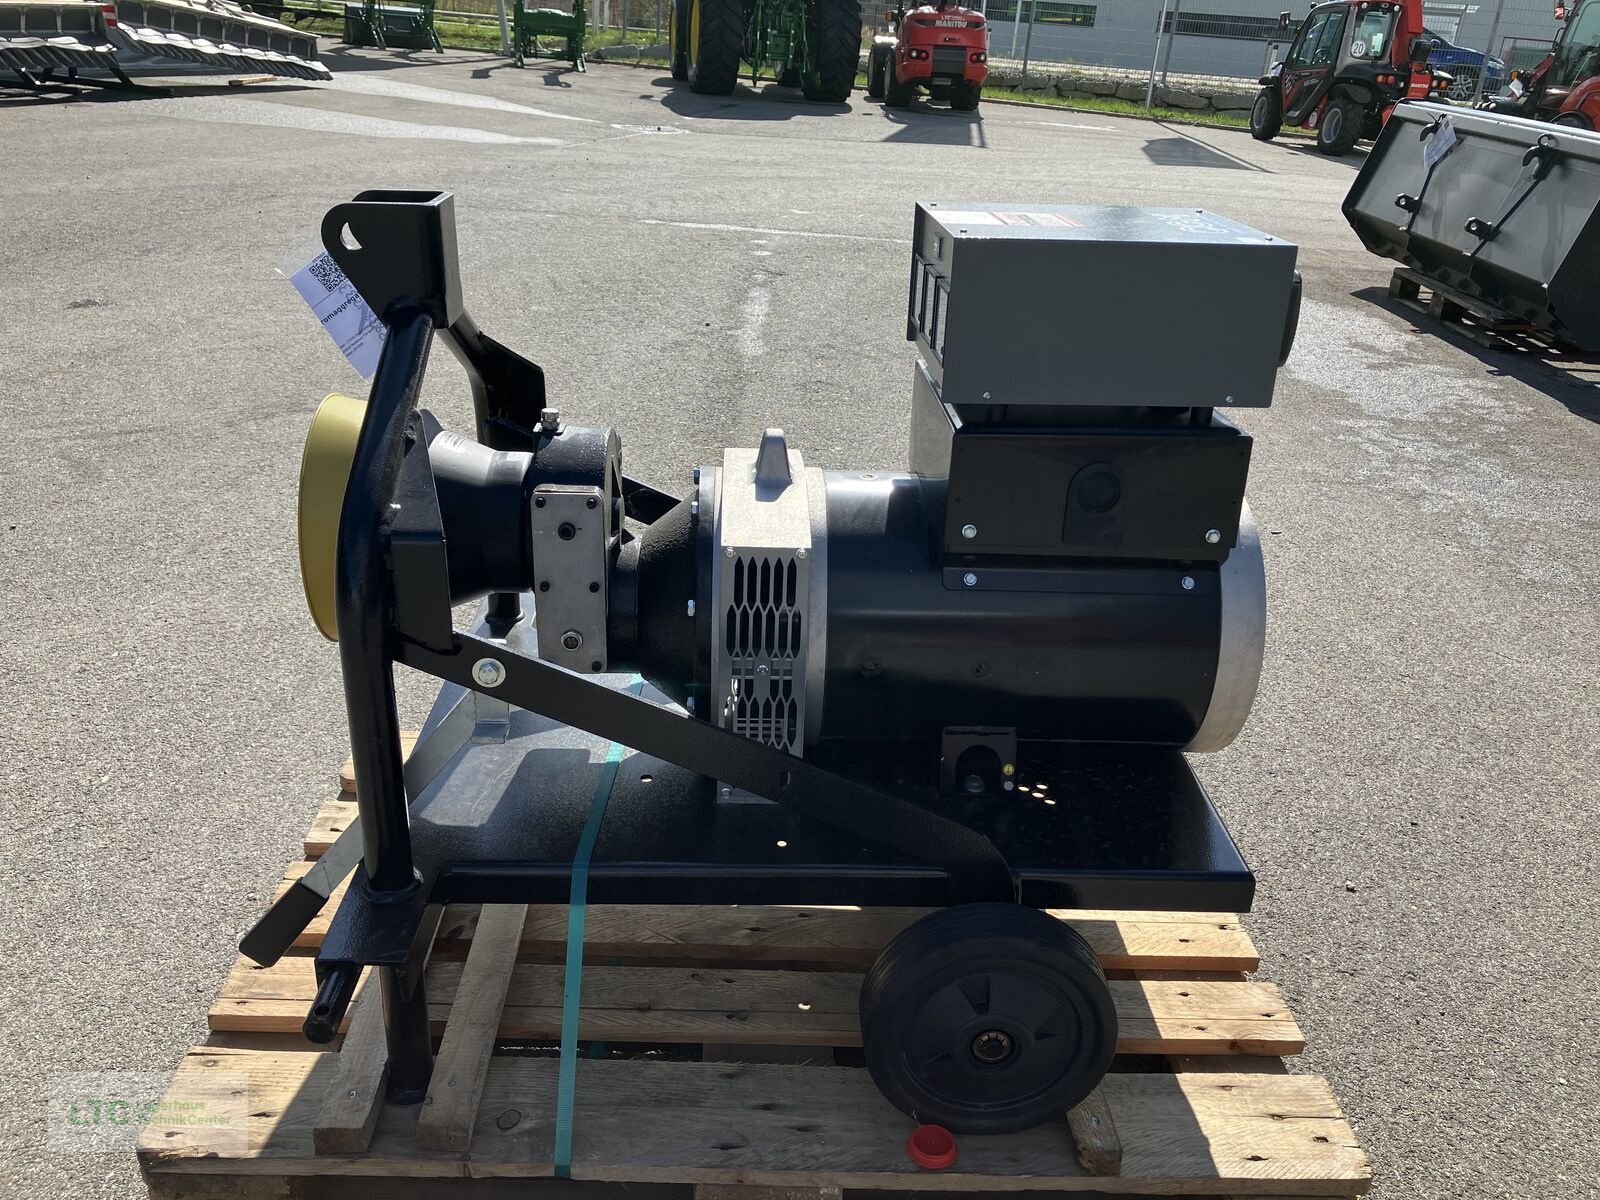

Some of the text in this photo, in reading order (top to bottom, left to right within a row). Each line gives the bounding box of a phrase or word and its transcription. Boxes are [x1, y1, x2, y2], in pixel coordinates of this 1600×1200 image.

[935, 20, 968, 28] MANITOU
[1353, 43, 1363, 54] 20
[320, 292, 361, 325] romaggrega
